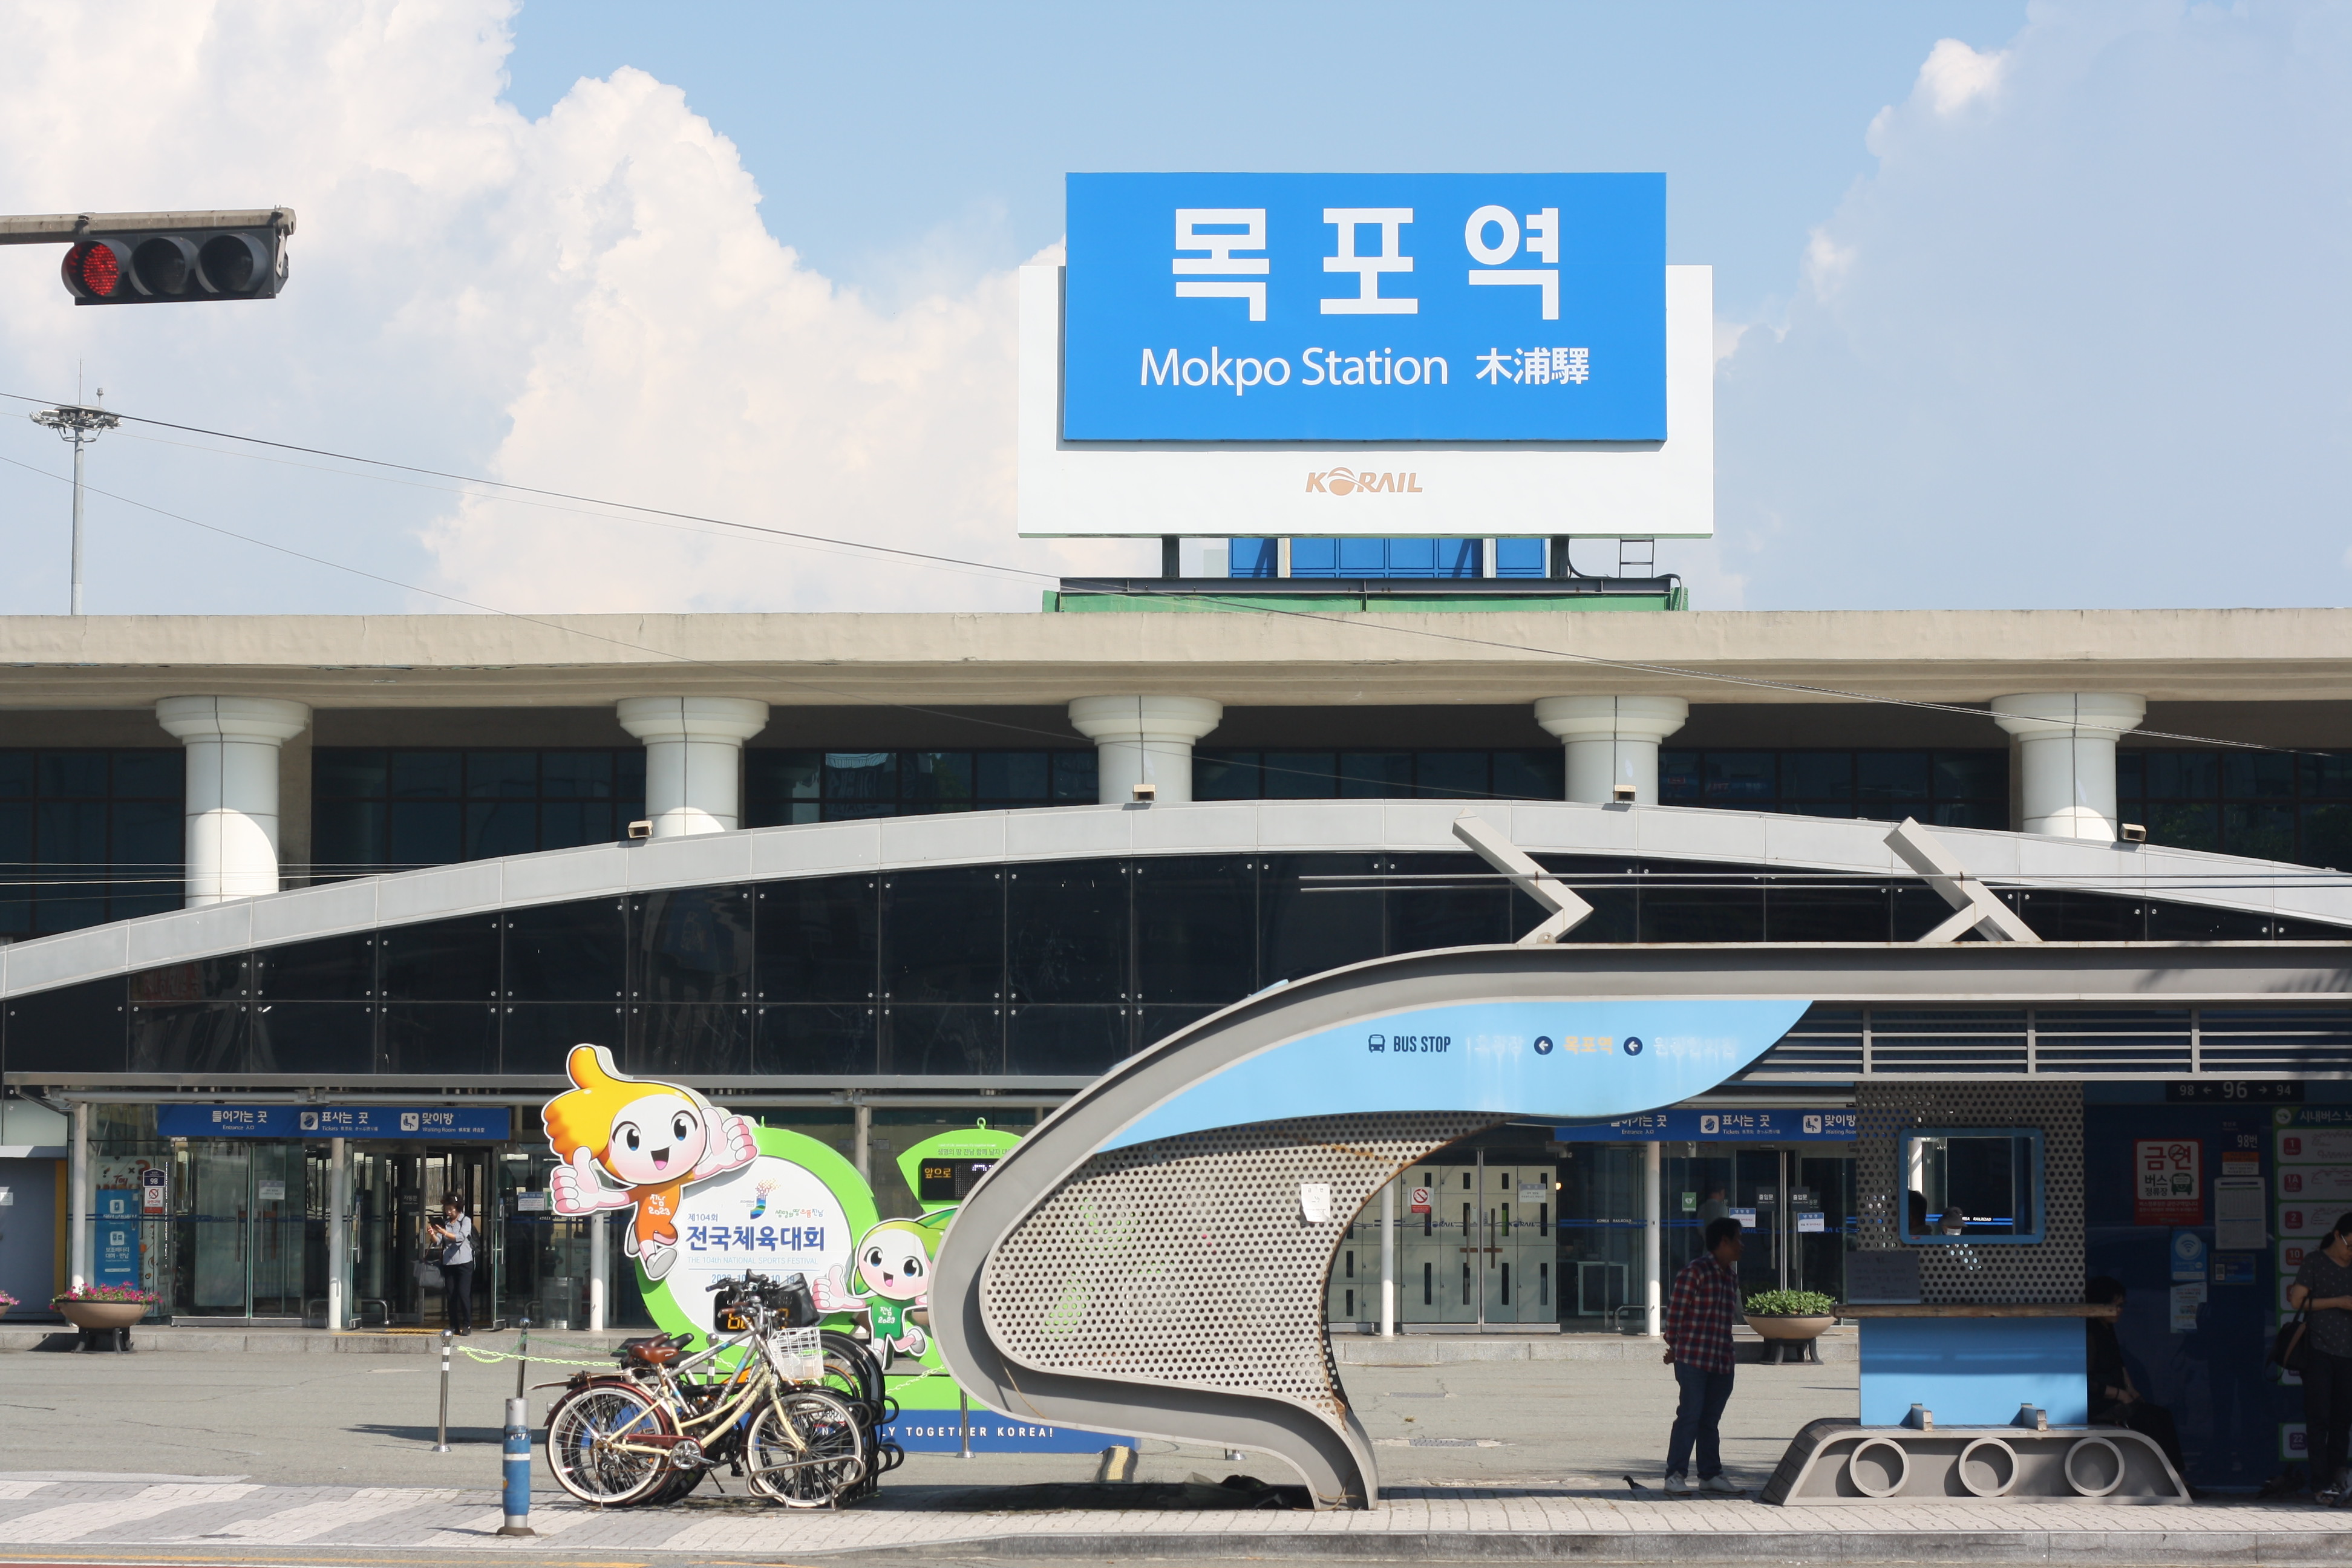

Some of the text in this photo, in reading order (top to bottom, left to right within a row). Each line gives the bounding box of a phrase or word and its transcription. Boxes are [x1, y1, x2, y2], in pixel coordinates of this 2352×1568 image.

[1172, 204, 1559, 321] 목포역
[1140, 346, 1589, 396] Mokpo Station 木浦驛
[1305, 467, 1423, 496] KORAIL
[1393, 1036, 1417, 1053] BUS
[1422, 1036, 1451, 1053] STOP
[1564, 1036, 1612, 1055] 목포역
[2179, 1080, 2292, 1099] 98 96 94
[212, 1110, 267, 1123] 들어가는 곳
[321, 1112, 368, 1125] 표사는 곳
[422, 1112, 454, 1125] 맞이방
[1657, 1116, 1667, 1128] 곳
[1722, 1116, 1771, 1128] 표사는 곳
[1824, 1116, 1857, 1128] 맞이방
[2299, 1110, 2342, 1123] 시내버스
[2237, 1134, 2258, 1149] 98번
[2145, 1144, 2191, 1171] 금연
[924, 1168, 952, 1179] 앞으로
[2145, 1174, 2167, 1186] 버스
[2145, 1187, 2168, 1197] 정류장
[648, 1206, 671, 1216] 2023
[687, 1213, 719, 1222] 제104회
[2291, 1213, 2296, 1221] 2
[685, 1226, 825, 1252] 전국체육대회
[998, 1426, 1053, 1437] KOREA!
[2293, 1434, 2304, 1443] 22
